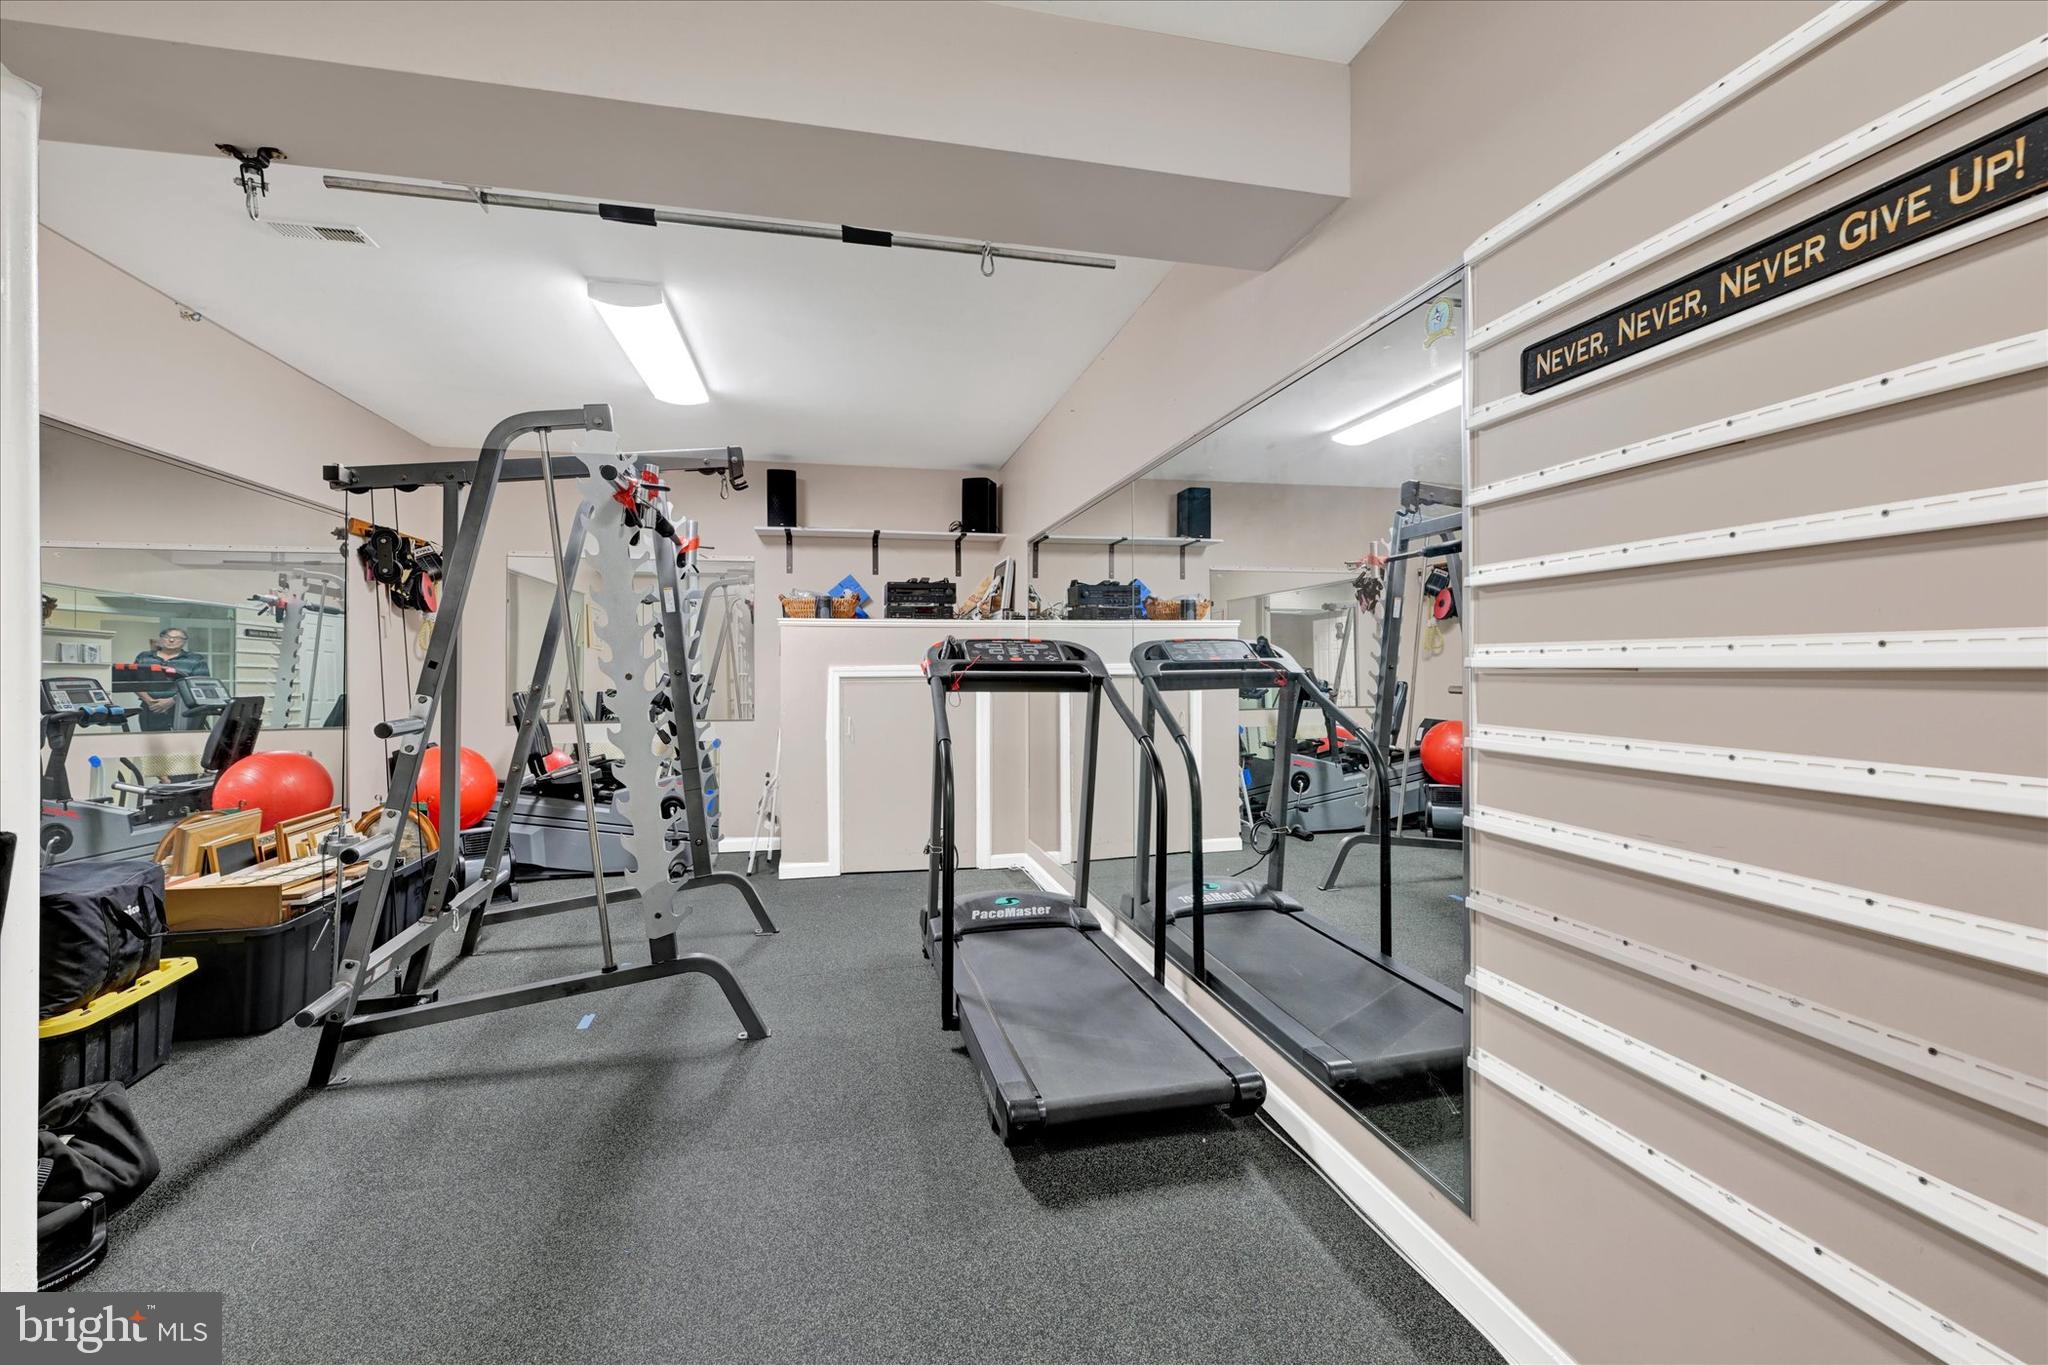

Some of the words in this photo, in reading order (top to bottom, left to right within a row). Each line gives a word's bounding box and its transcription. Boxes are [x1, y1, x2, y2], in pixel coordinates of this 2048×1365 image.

[1536, 331, 1609, 379] NEVER,
[1617, 289, 1708, 346] NEVER,
[1719, 234, 1826, 305] NEVER
[1839, 184, 1932, 251] GIVE
[1949, 135, 2026, 205] UP!
[971, 905, 1052, 920] PaceMaster
